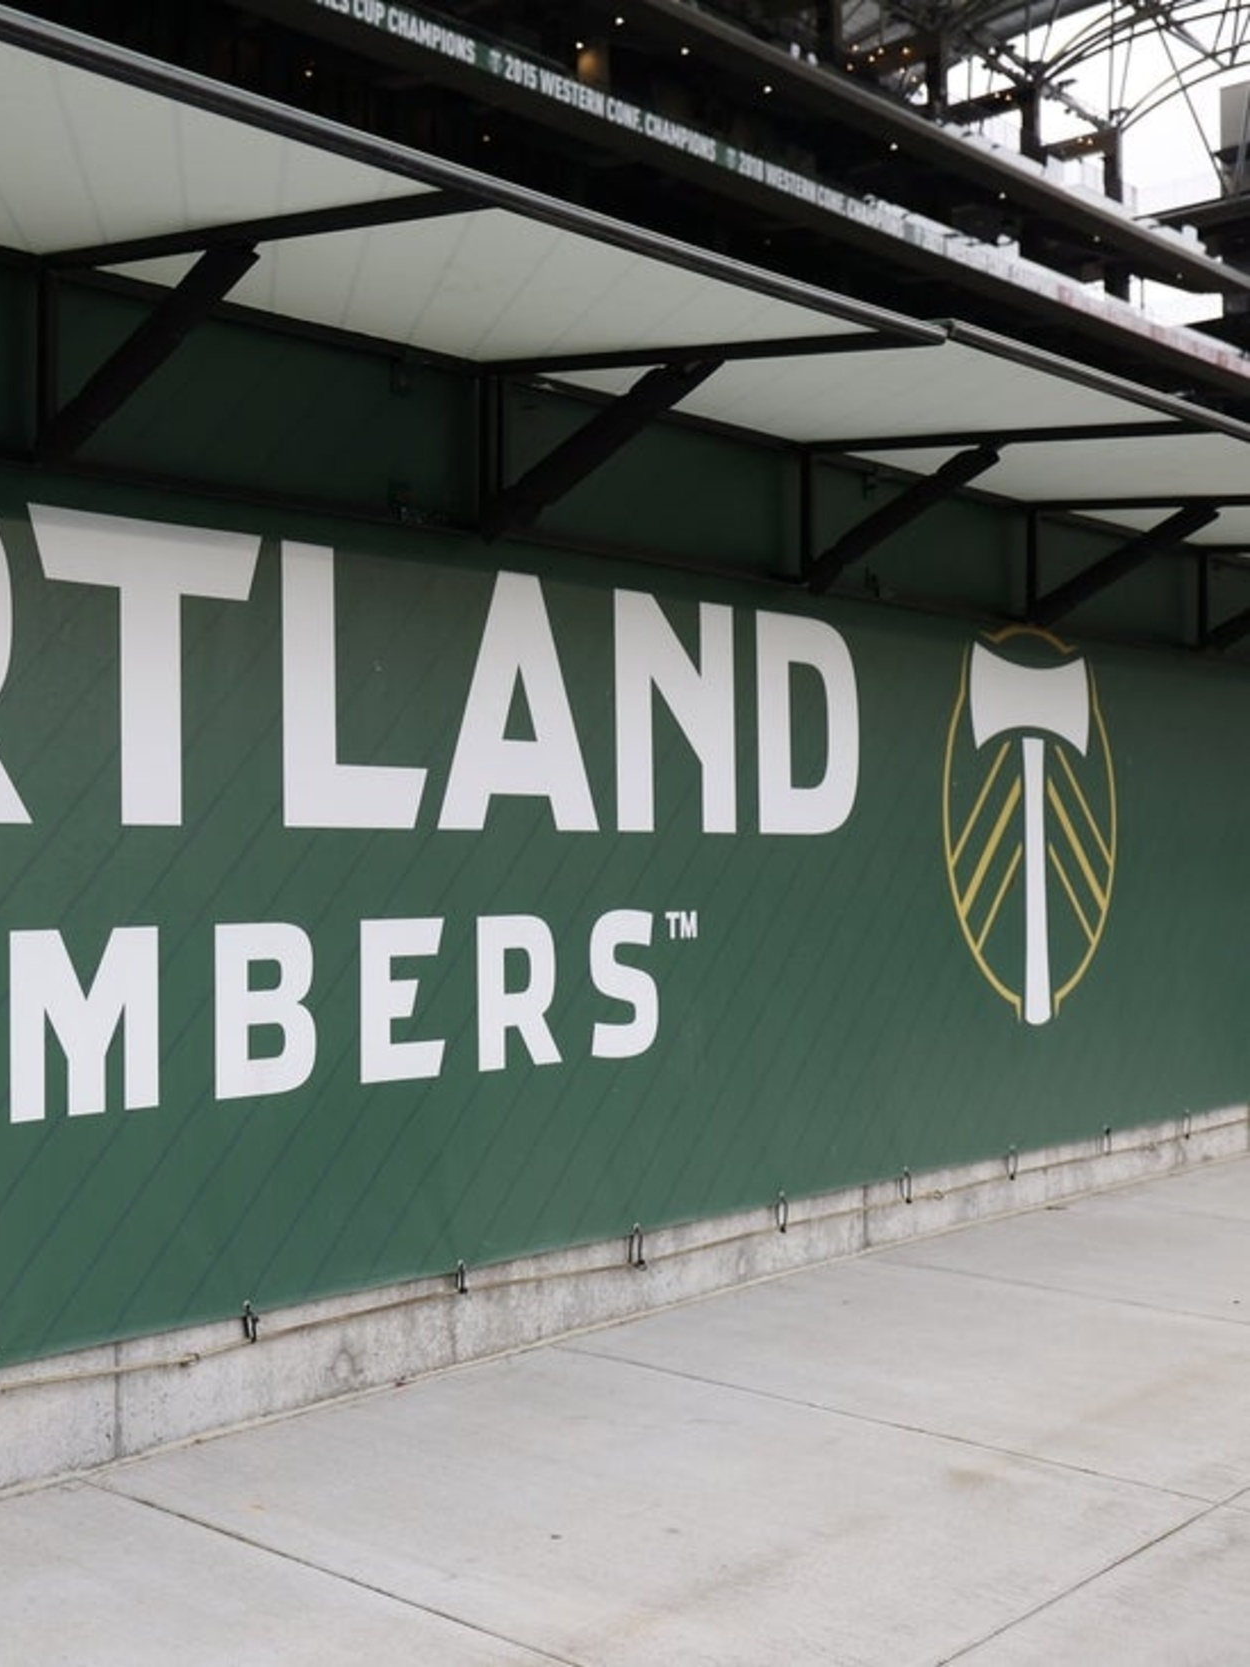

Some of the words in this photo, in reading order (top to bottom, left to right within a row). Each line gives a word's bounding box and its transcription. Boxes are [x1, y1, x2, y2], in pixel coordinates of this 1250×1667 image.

[353, 0, 385, 27] CUP
[387, 7, 476, 65] CHAMPIONS
[504, 54, 538, 90] 2015
[540, 67, 605, 118] WESTERN
[606, 97, 643, 133] CONF.
[644, 113, 717, 162] CHAMPIONS
